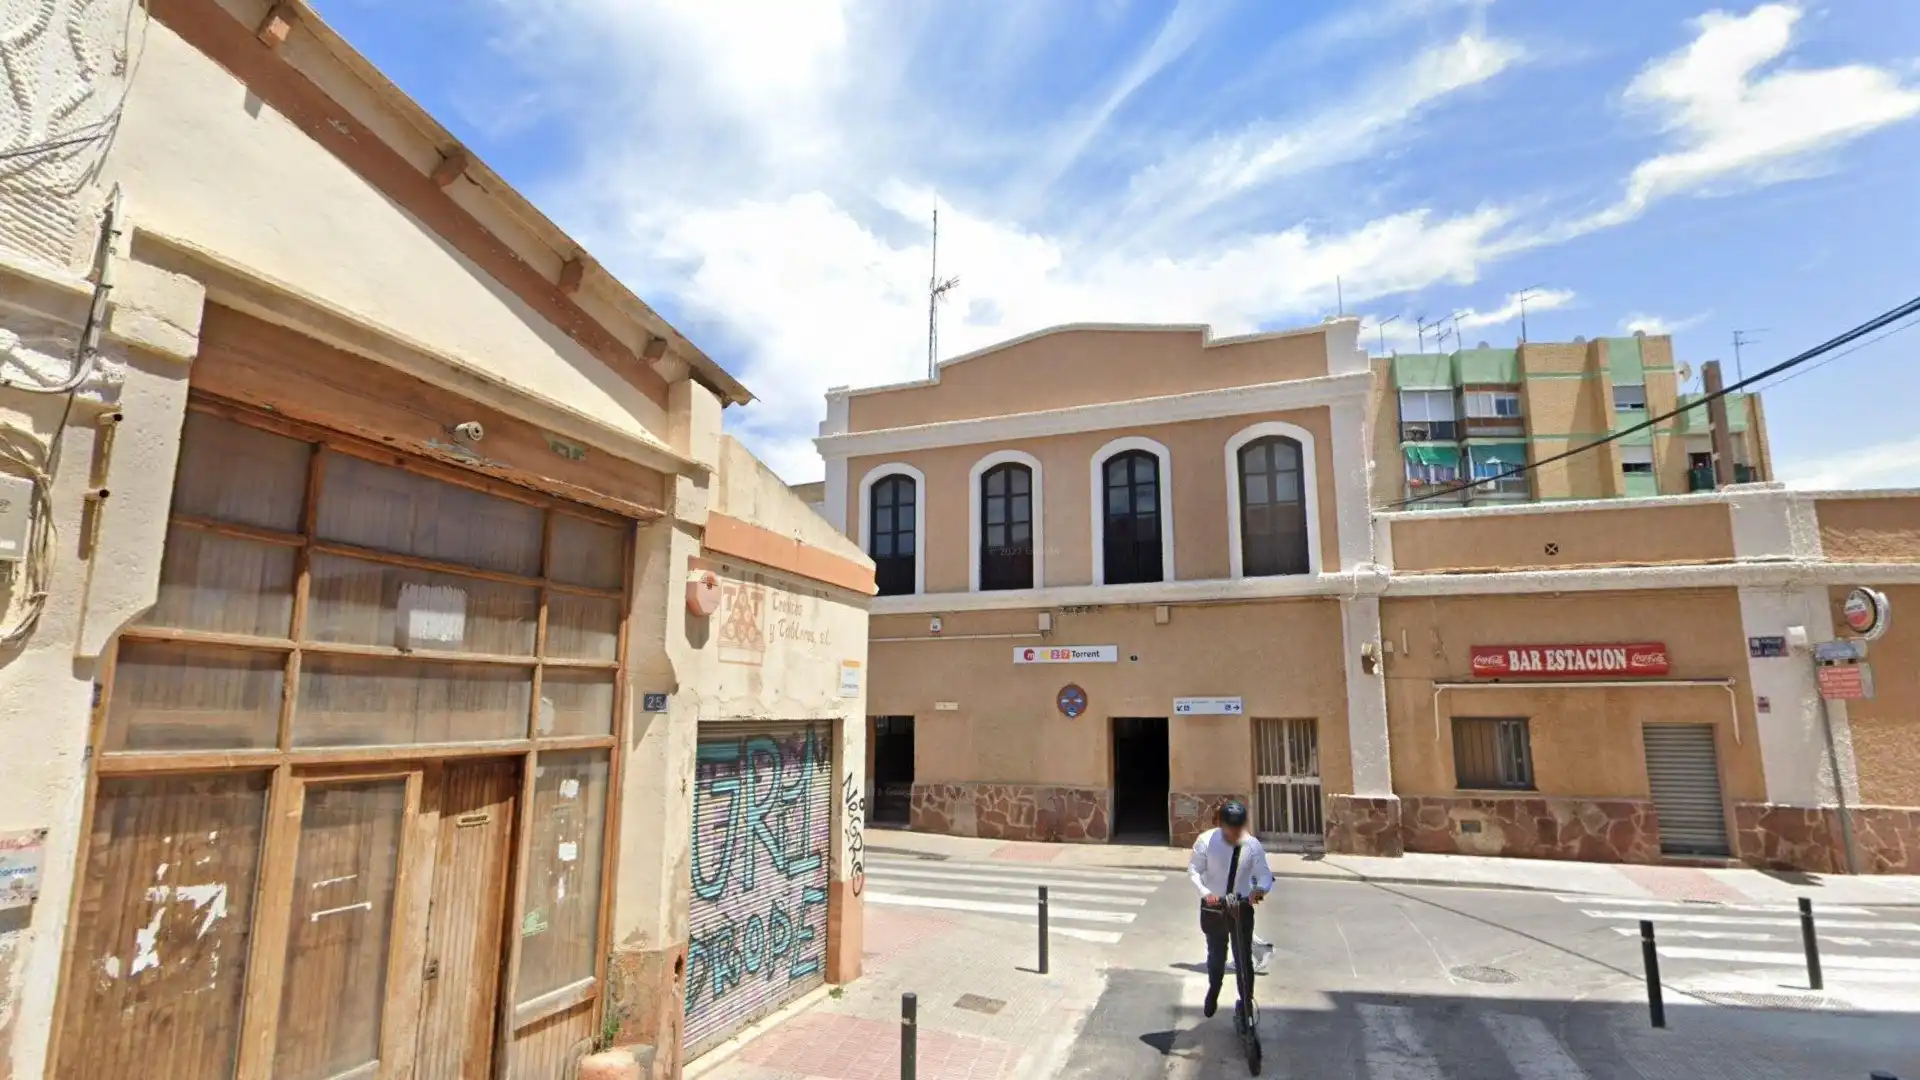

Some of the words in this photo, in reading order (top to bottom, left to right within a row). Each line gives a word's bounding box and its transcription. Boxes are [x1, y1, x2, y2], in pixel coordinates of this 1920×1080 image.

[1071, 649, 1100, 658] Torrent
[1509, 650, 1541, 671] BAR
[1545, 648, 1627, 671] ESTACION
